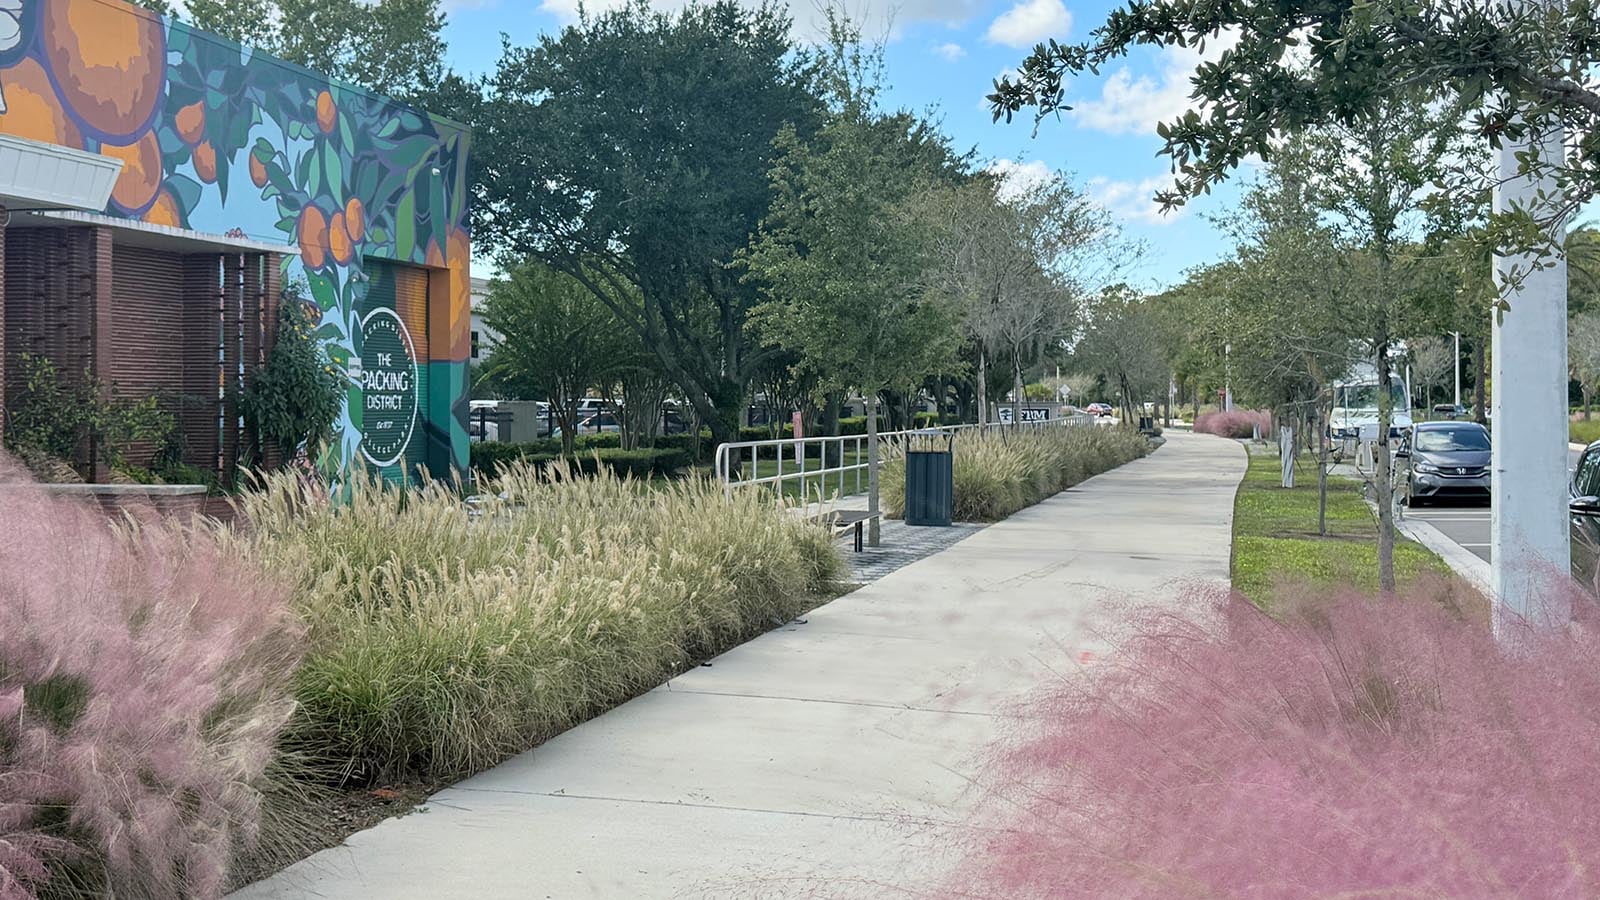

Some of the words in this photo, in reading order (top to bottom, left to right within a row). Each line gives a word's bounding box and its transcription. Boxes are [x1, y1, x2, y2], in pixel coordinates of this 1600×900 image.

[377, 353, 392, 367] THE
[362, 370, 408, 391] PACKING
[367, 394, 402, 410] DISTRICT
